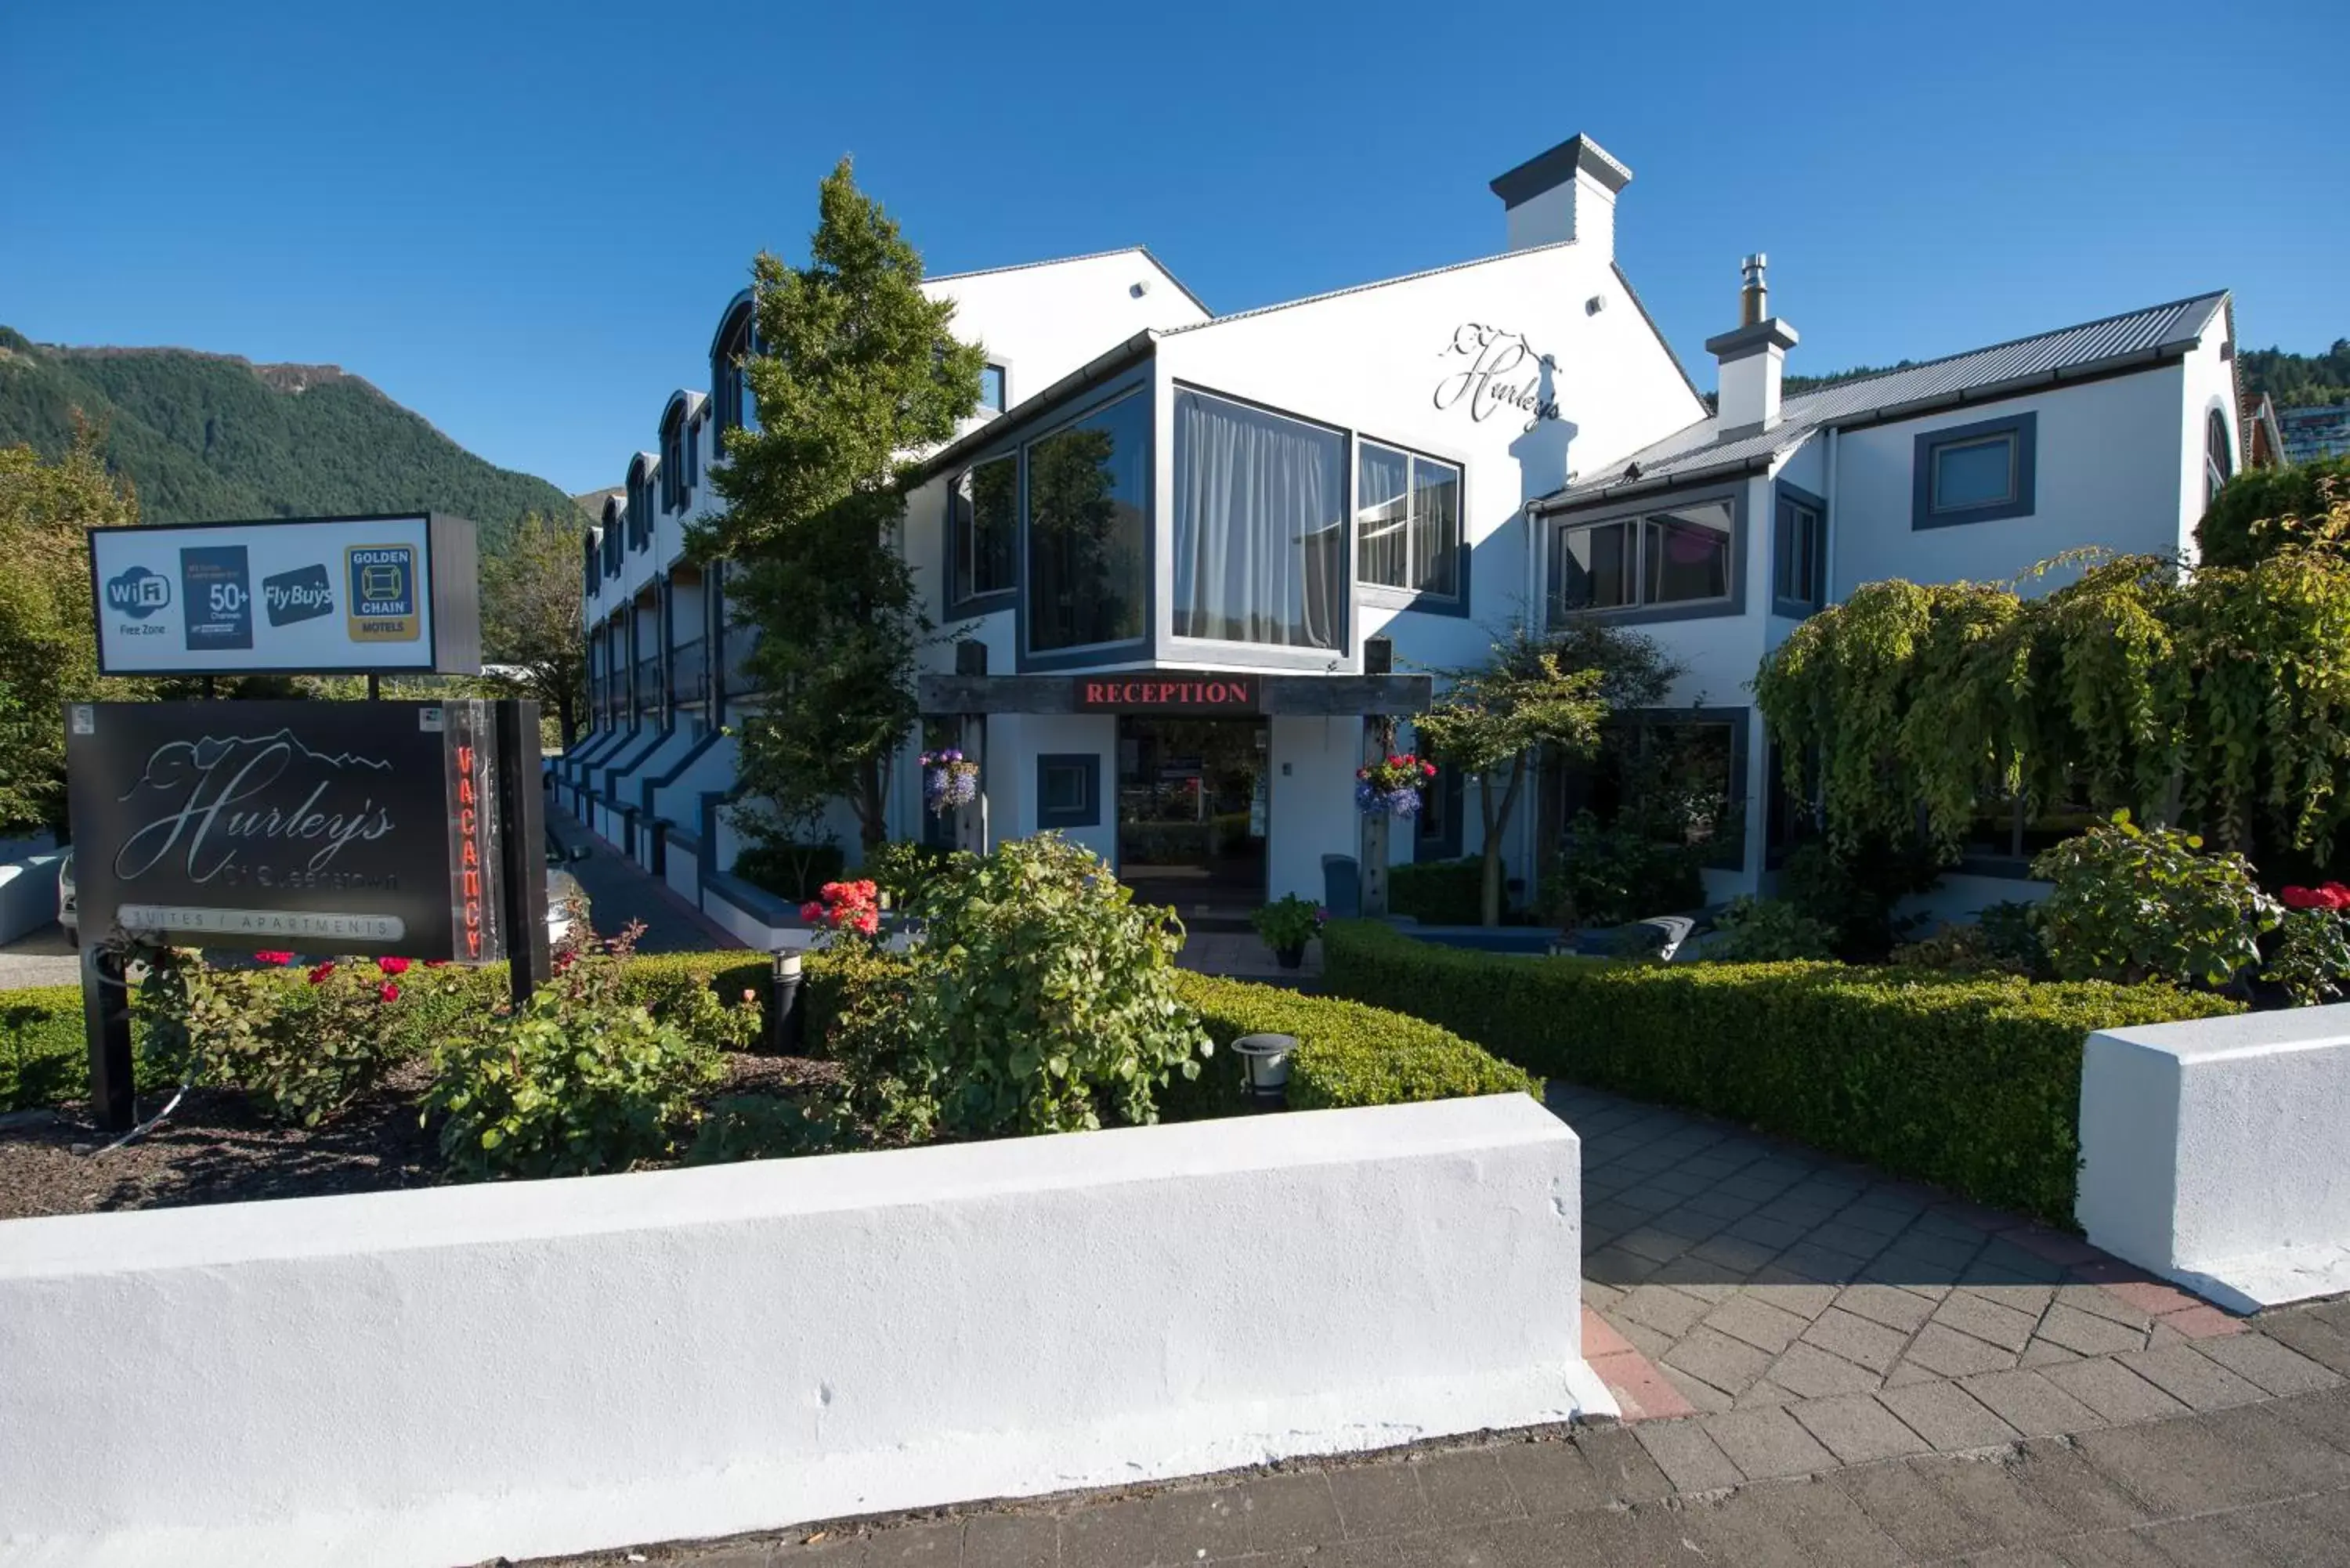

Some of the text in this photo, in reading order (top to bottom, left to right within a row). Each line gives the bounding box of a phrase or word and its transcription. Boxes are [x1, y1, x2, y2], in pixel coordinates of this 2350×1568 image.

[1433, 330, 1562, 433] Hurley's
[352, 551, 409, 565] GOLDEN
[109, 579, 163, 605] WiFi
[209, 583, 248, 611] 50+
[264, 580, 334, 609] FlyBuys
[361, 602, 406, 614] CHAIN
[120, 624, 165, 635] Free Zone
[361, 621, 405, 634] MOTELS
[1085, 681, 1249, 703] RECEPTION
[113, 739, 396, 884] Hurley's
[458, 746, 482, 957] VACANCY
[132, 910, 204, 926] SUITES
[241, 916, 389, 937] APARTMENTS
